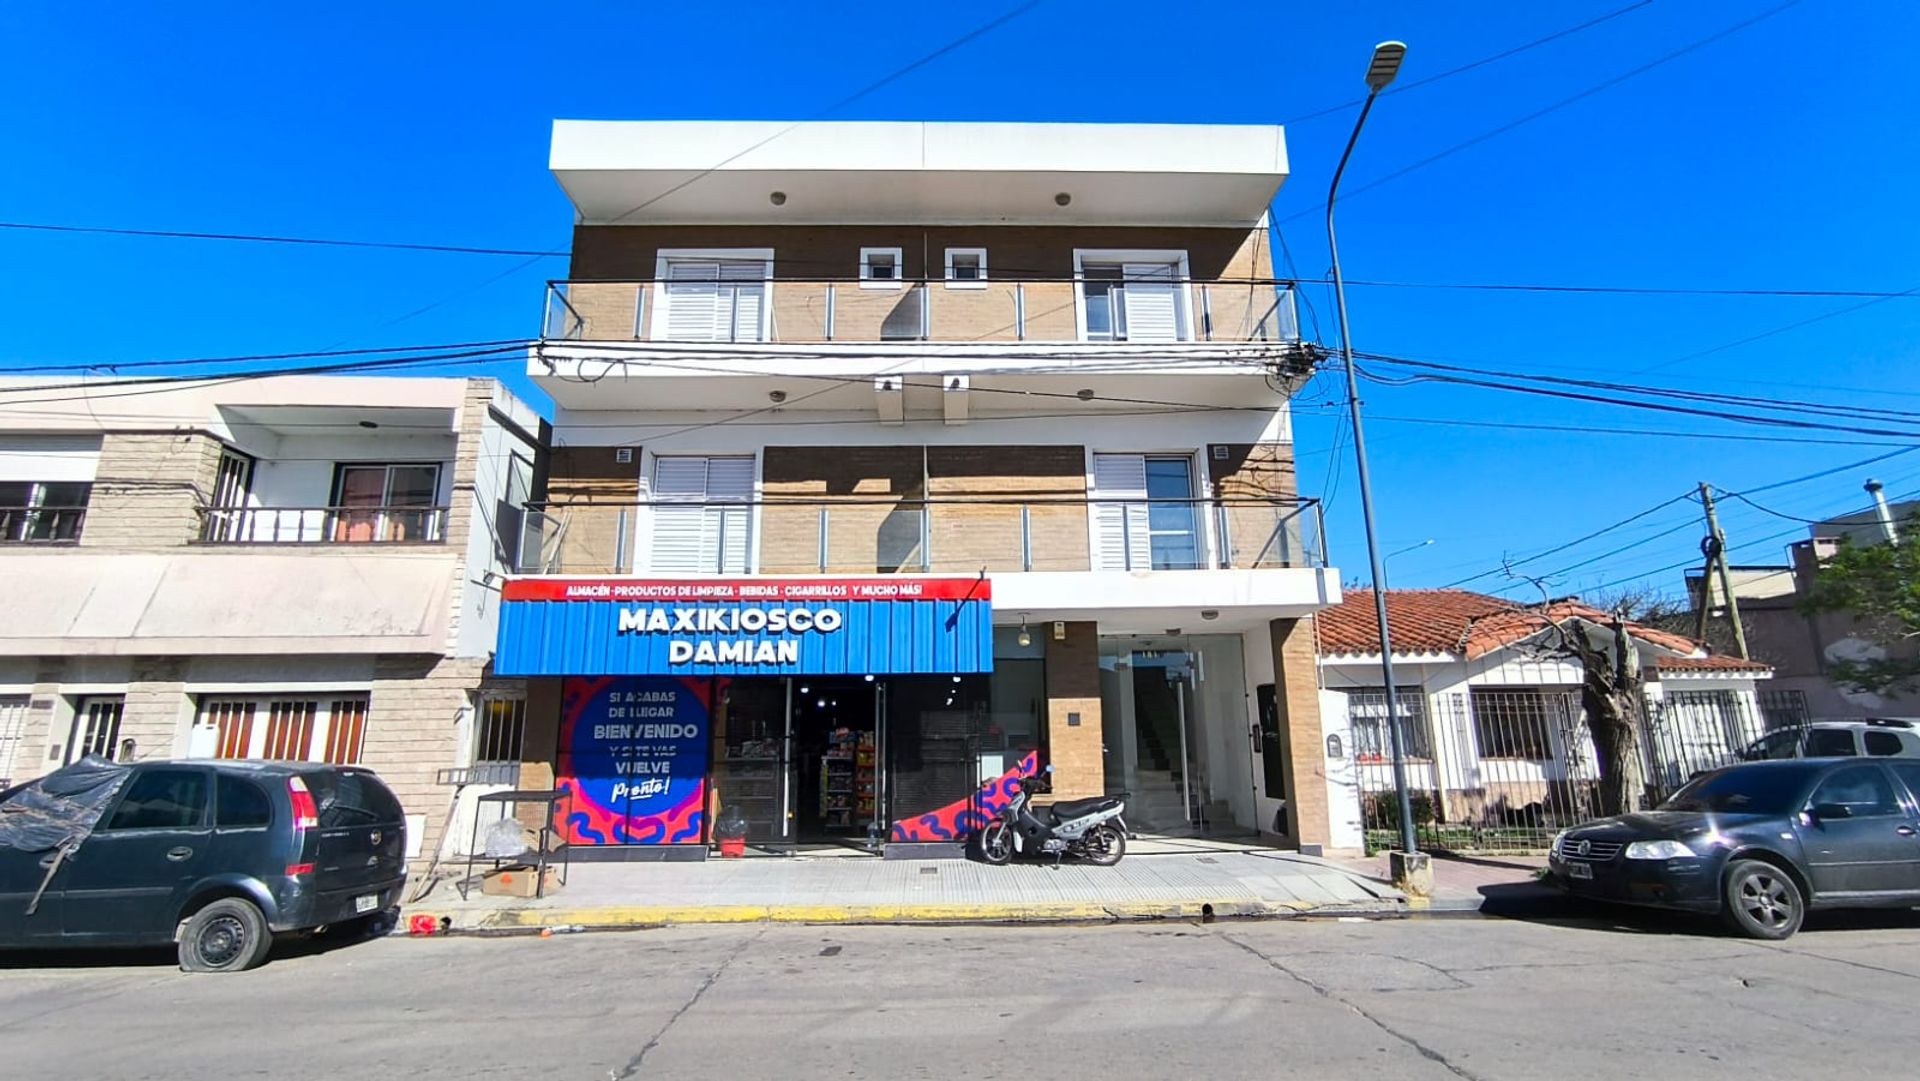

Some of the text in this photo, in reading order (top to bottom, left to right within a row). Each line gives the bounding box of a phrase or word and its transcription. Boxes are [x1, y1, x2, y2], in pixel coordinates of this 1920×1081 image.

[566, 582, 923, 596] ALMACÉN PRODUCTOS DE LIMPIEZA BEBIDAS CIGARRILLOS Y MUCHO MÁS!
[618, 608, 842, 633] MAXIKIOSCO
[669, 640, 798, 664] DAMIAN
[609, 692, 621, 703] SI
[608, 707, 625, 718] DE
[594, 724, 698, 739] BIENVENIDO
[609, 746, 619, 757] Y
[635, 746, 650, 757] TE
[652, 745, 677, 756] VAS
[615, 761, 670, 774] VUELVE
